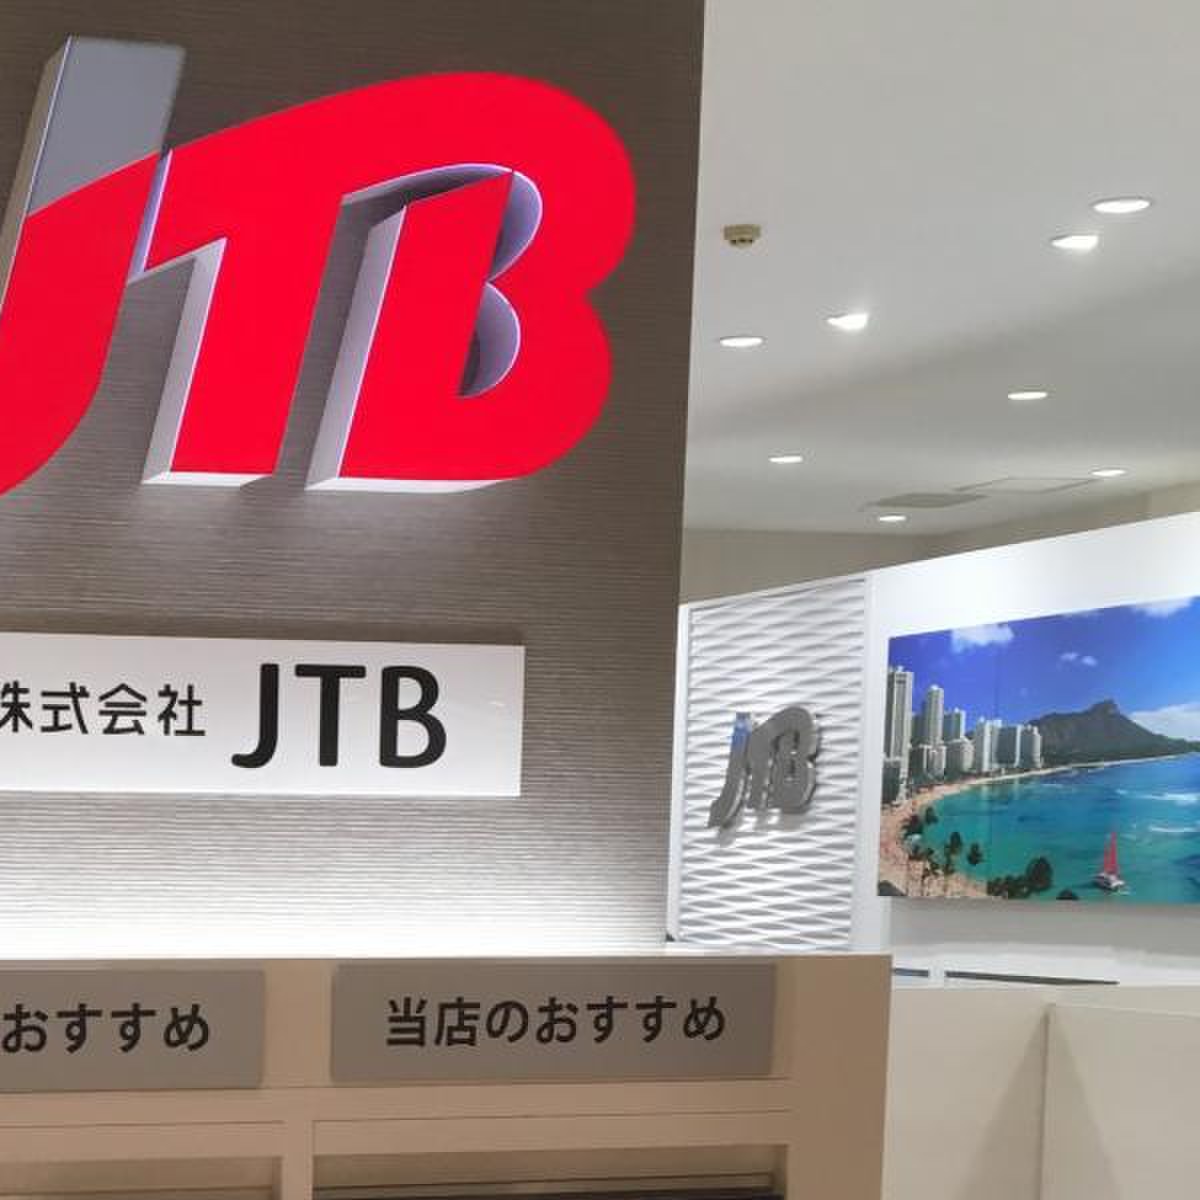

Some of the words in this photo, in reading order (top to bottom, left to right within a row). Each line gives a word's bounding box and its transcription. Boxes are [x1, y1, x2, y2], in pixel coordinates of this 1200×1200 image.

[231, 663, 447, 769] JTB
[707, 706, 821, 830] JTB
[386, 996, 726, 1048] 当店のおすすめ
